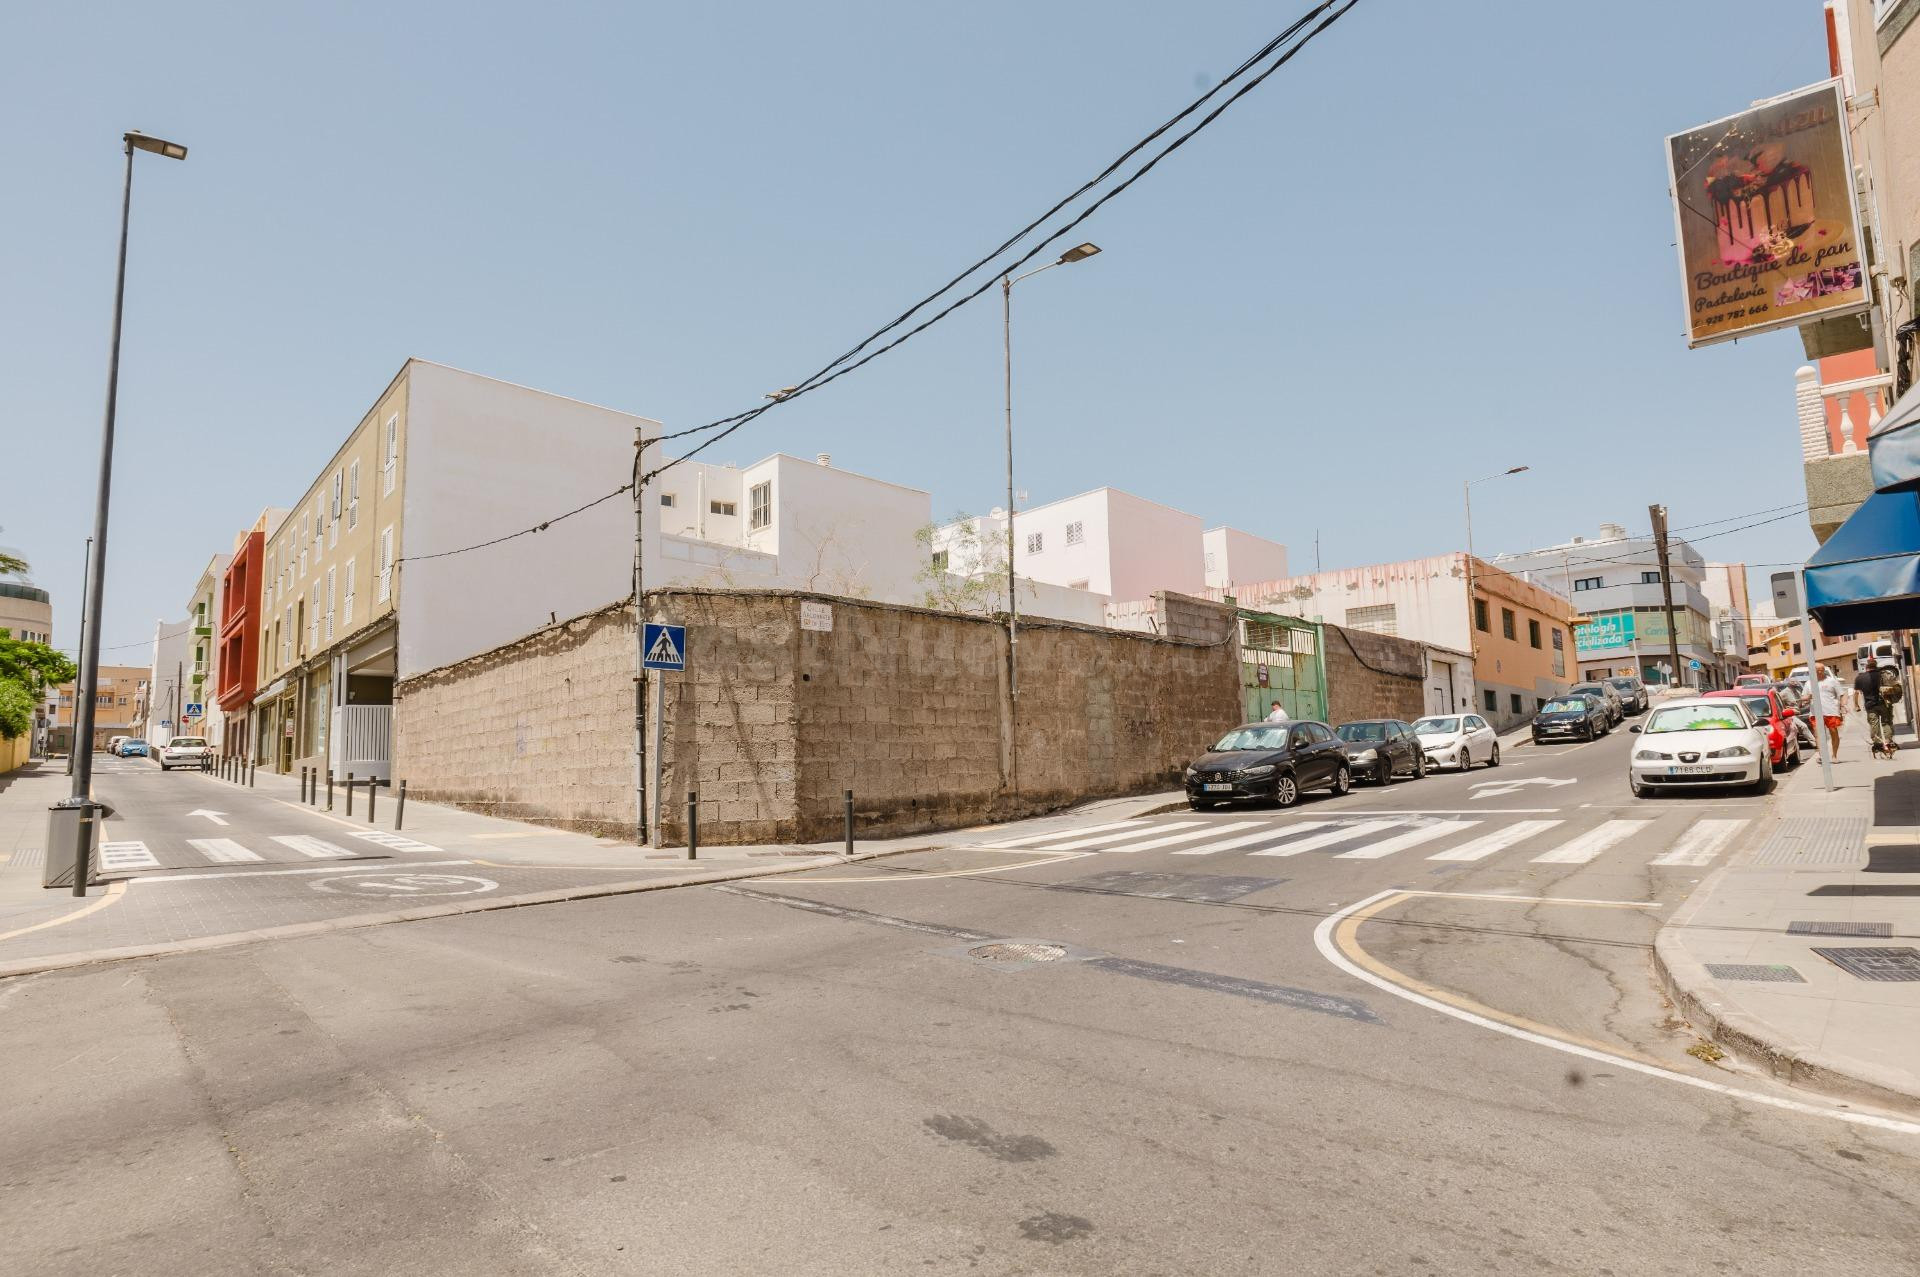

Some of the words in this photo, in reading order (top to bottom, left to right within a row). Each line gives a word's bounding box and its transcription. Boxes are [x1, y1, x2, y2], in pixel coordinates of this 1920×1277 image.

[1695, 262, 1781, 290] Boutique
[1786, 244, 1811, 267] de
[1814, 242, 1853, 267] pan
[1694, 284, 1767, 312] Pastelería
[1705, 313, 1724, 326] 928
[1727, 308, 1745, 320] 782
[1748, 303, 1769, 315] 666
